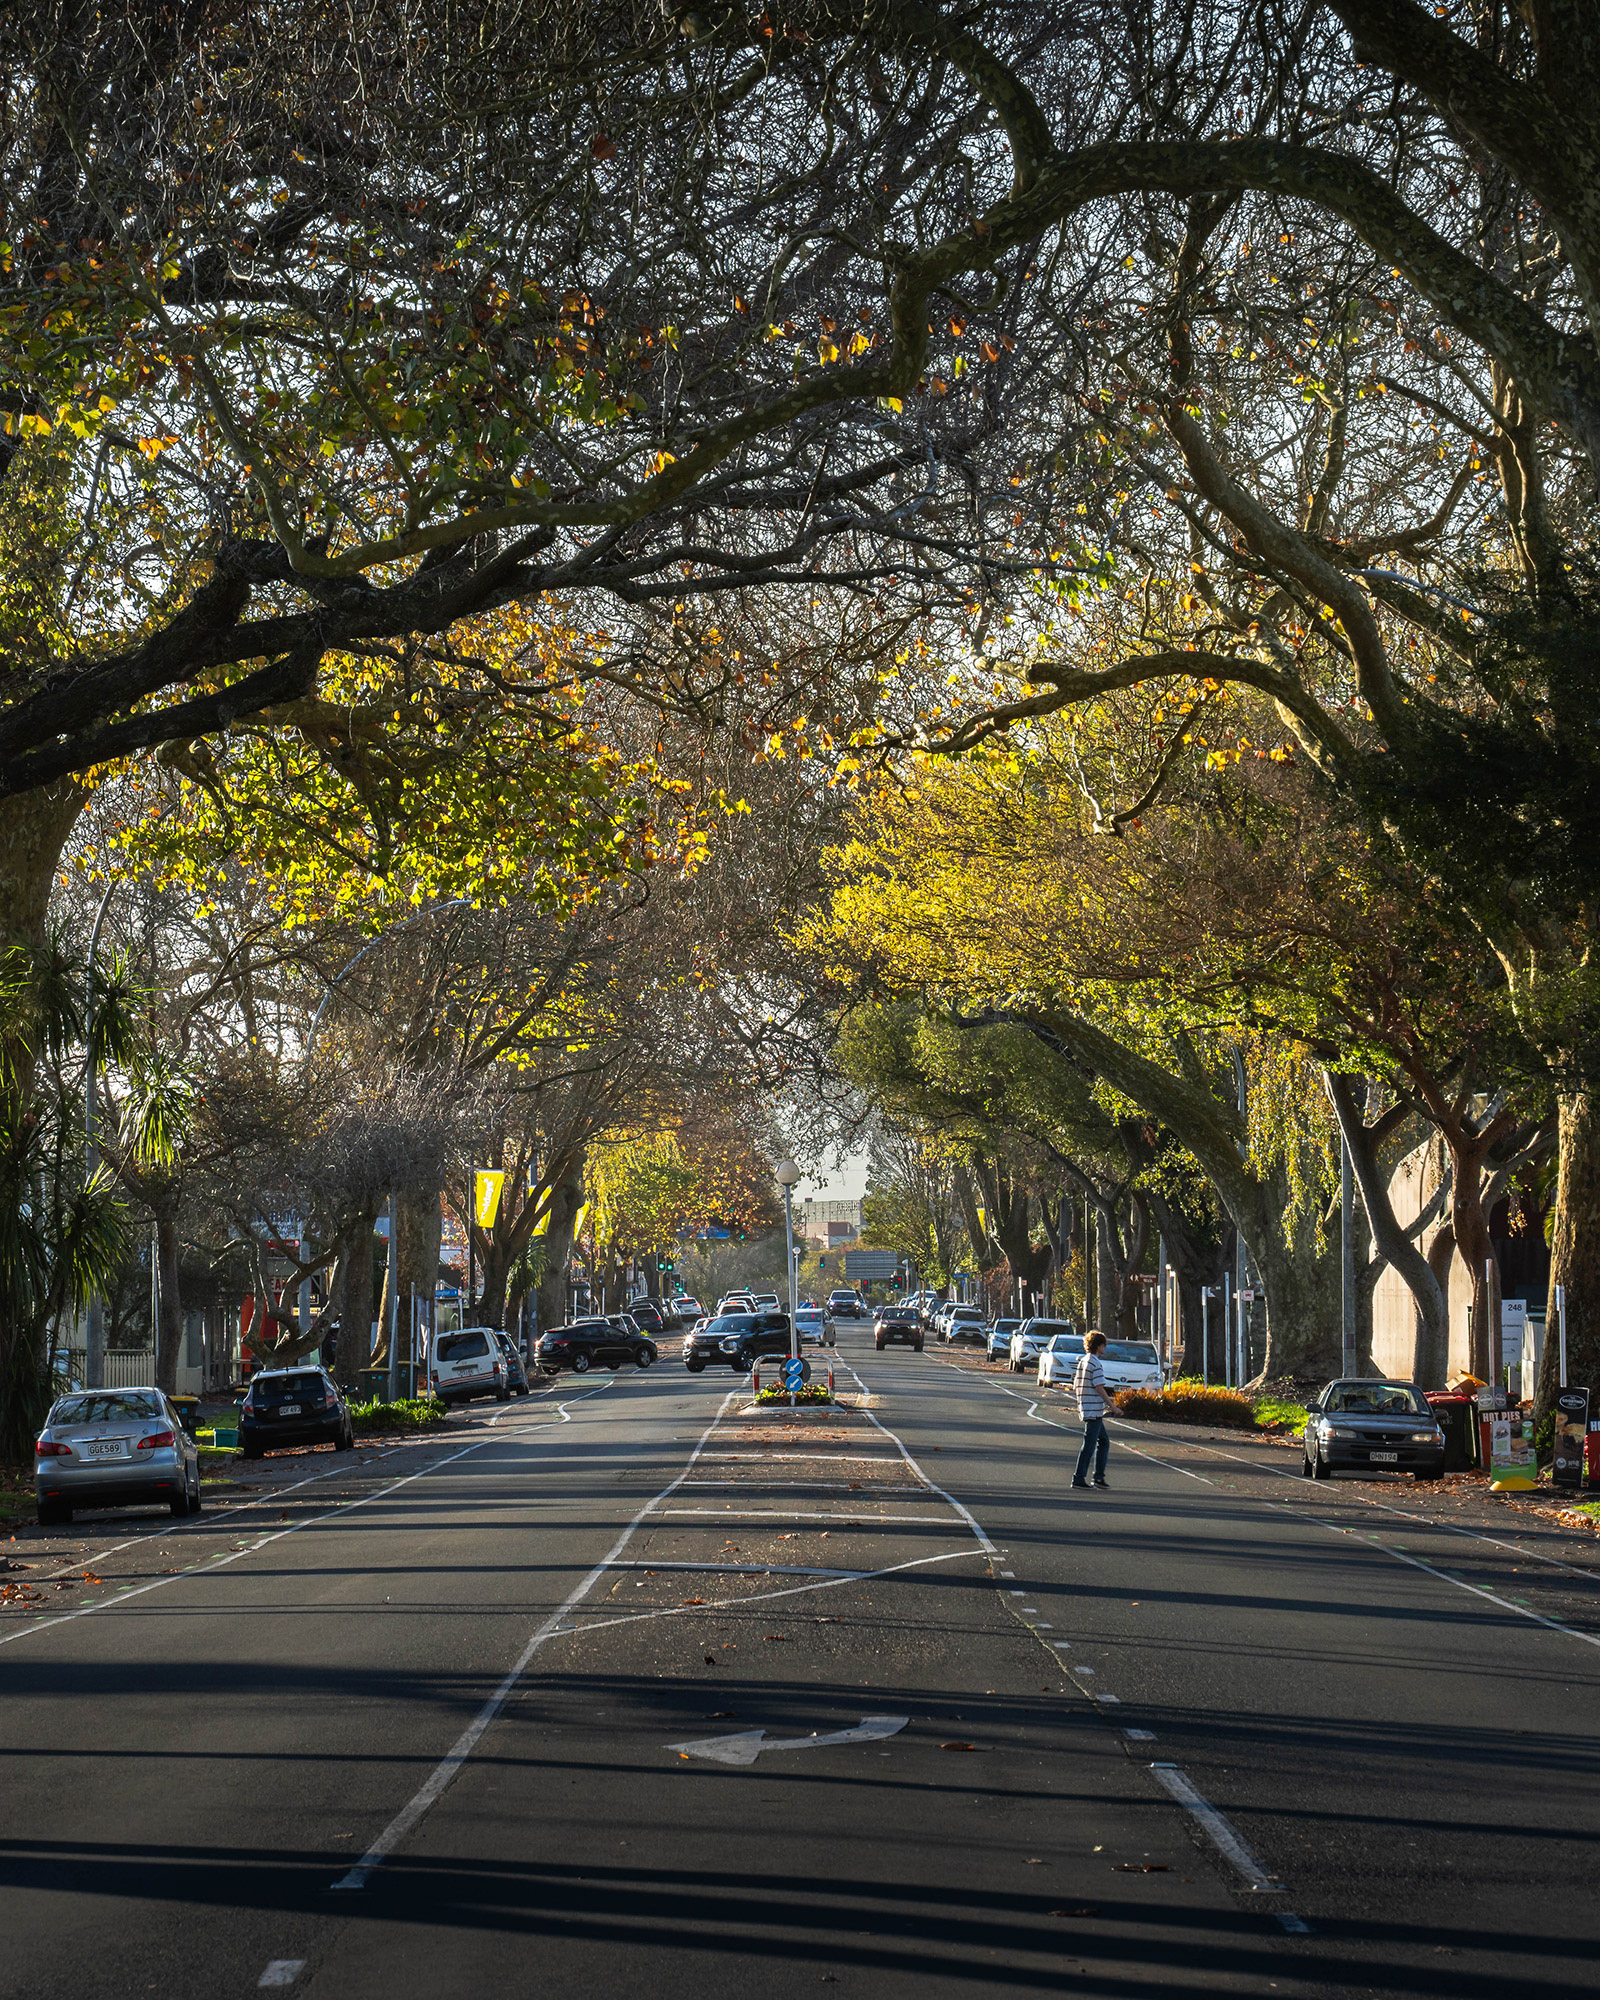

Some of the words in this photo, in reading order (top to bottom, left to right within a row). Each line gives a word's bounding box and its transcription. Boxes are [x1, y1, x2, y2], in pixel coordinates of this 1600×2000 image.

[1483, 1412, 1499, 1422] HOT
[1501, 1411, 1520, 1421] PIES
[89, 1443, 120, 1454] GGE589
